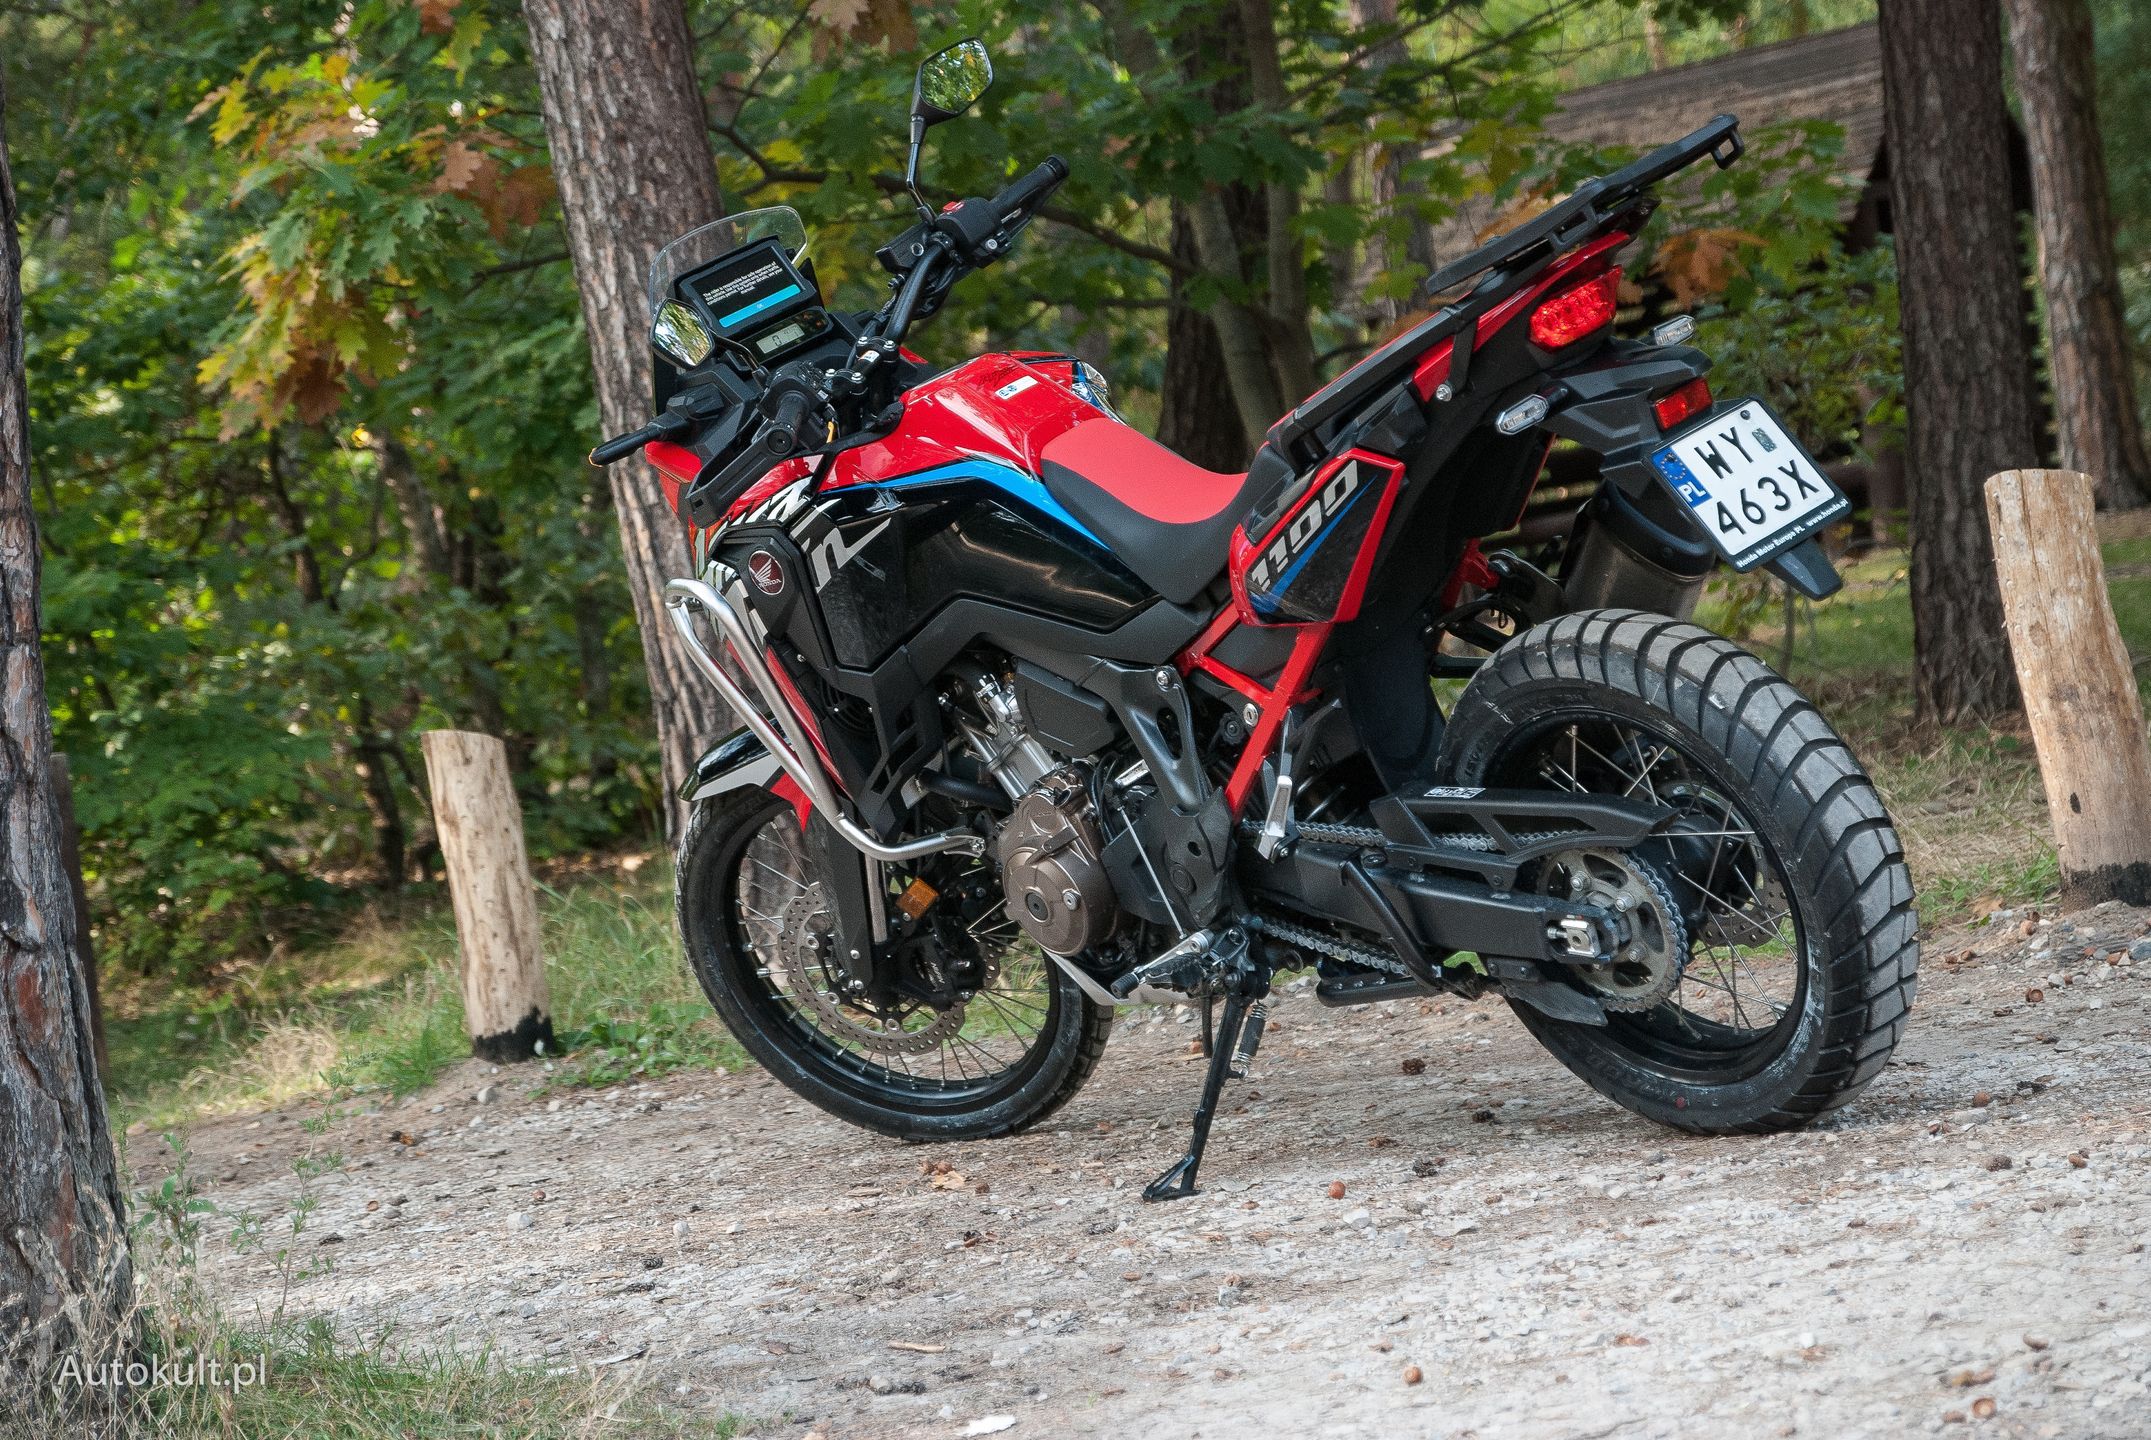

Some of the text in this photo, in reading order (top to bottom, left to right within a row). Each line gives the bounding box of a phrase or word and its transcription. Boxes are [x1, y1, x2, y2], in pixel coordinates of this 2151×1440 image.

[1694, 426, 1754, 479] WY
[1251, 459, 1358, 592] 1100
[1677, 481, 1707, 503] PL
[1716, 459, 1820, 535] 463X
[1736, 498, 1849, 568] Honda Motor Europe PL www.honda.pl
